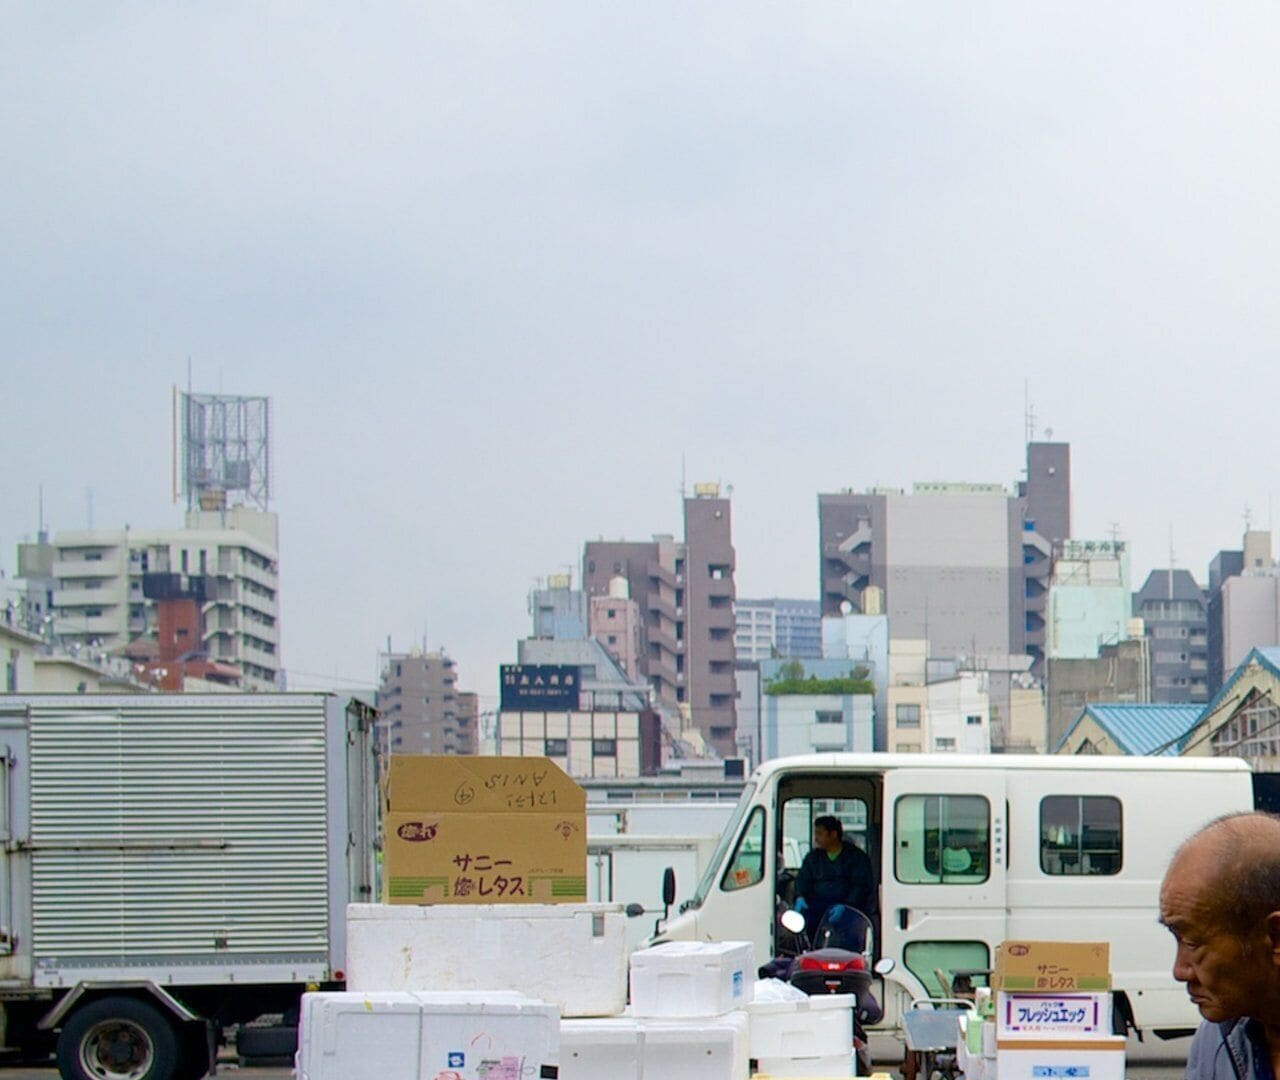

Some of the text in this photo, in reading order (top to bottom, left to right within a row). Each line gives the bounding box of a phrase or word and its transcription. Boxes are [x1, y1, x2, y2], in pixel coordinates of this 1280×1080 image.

[453, 854, 512, 872] サニー
[1037, 964, 1070, 975] サニー
[1018, 1008, 1087, 1023] フレッシュエッグ
